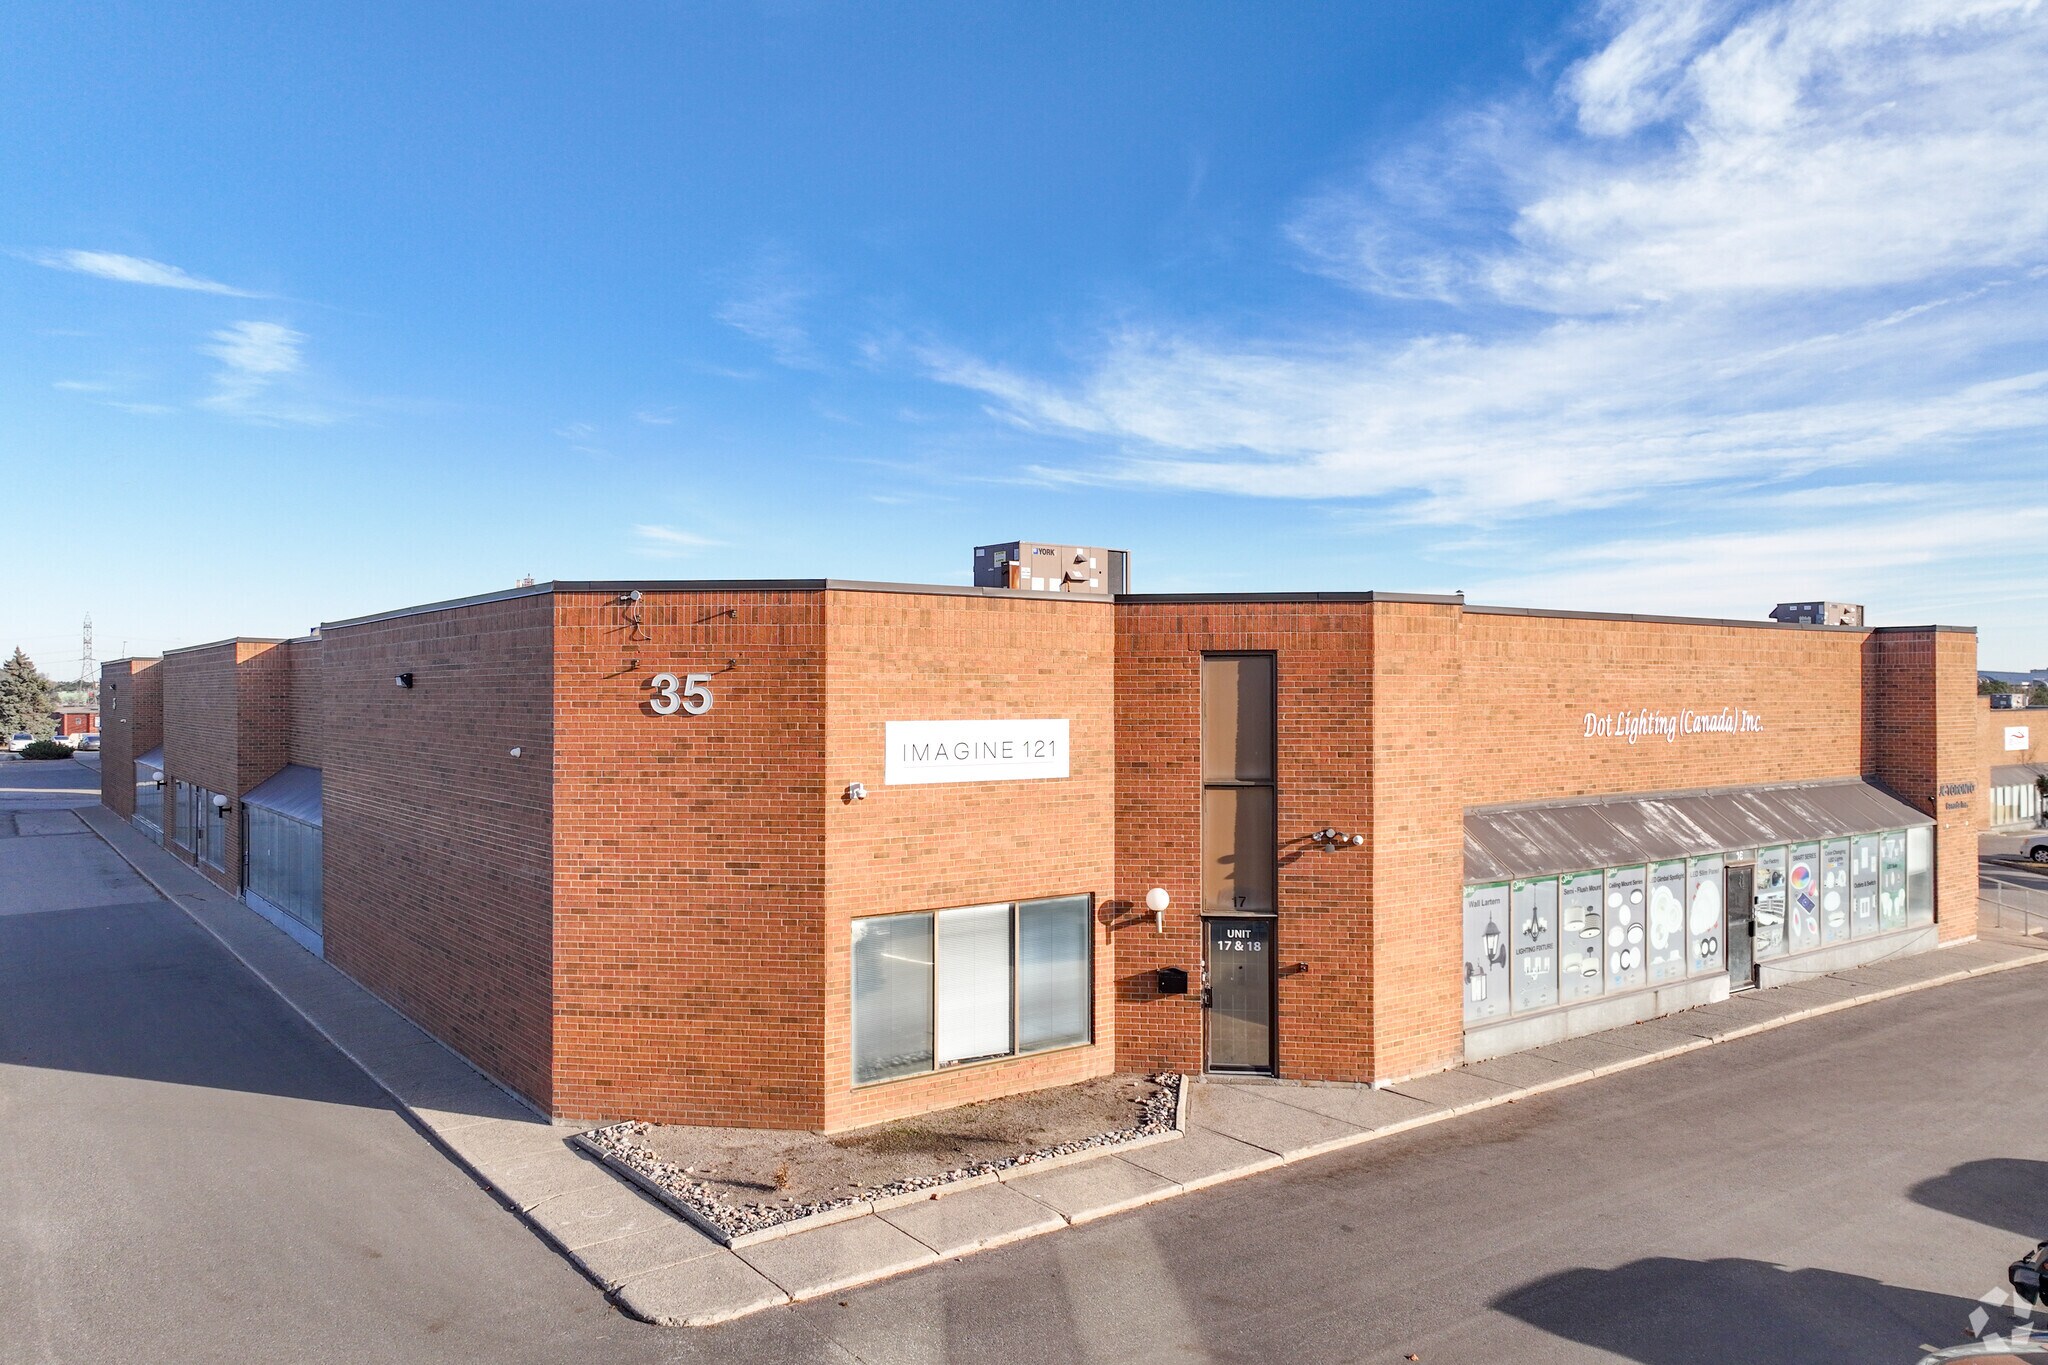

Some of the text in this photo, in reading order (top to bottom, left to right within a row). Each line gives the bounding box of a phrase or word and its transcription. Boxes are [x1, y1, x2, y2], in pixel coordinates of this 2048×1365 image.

[1038, 547, 1055, 556] YORK
[650, 673, 713, 715] 35
[1583, 707, 1764, 745] Dot Lighting (Canada) Inc.
[903, 740, 1055, 762] IMAGINE 121
[1232, 895, 1246, 907] 17
[1468, 898, 1481, 908] Wall
[1227, 929, 1251, 938] UNIT
[1217, 940, 1261, 951] 17 & 18
